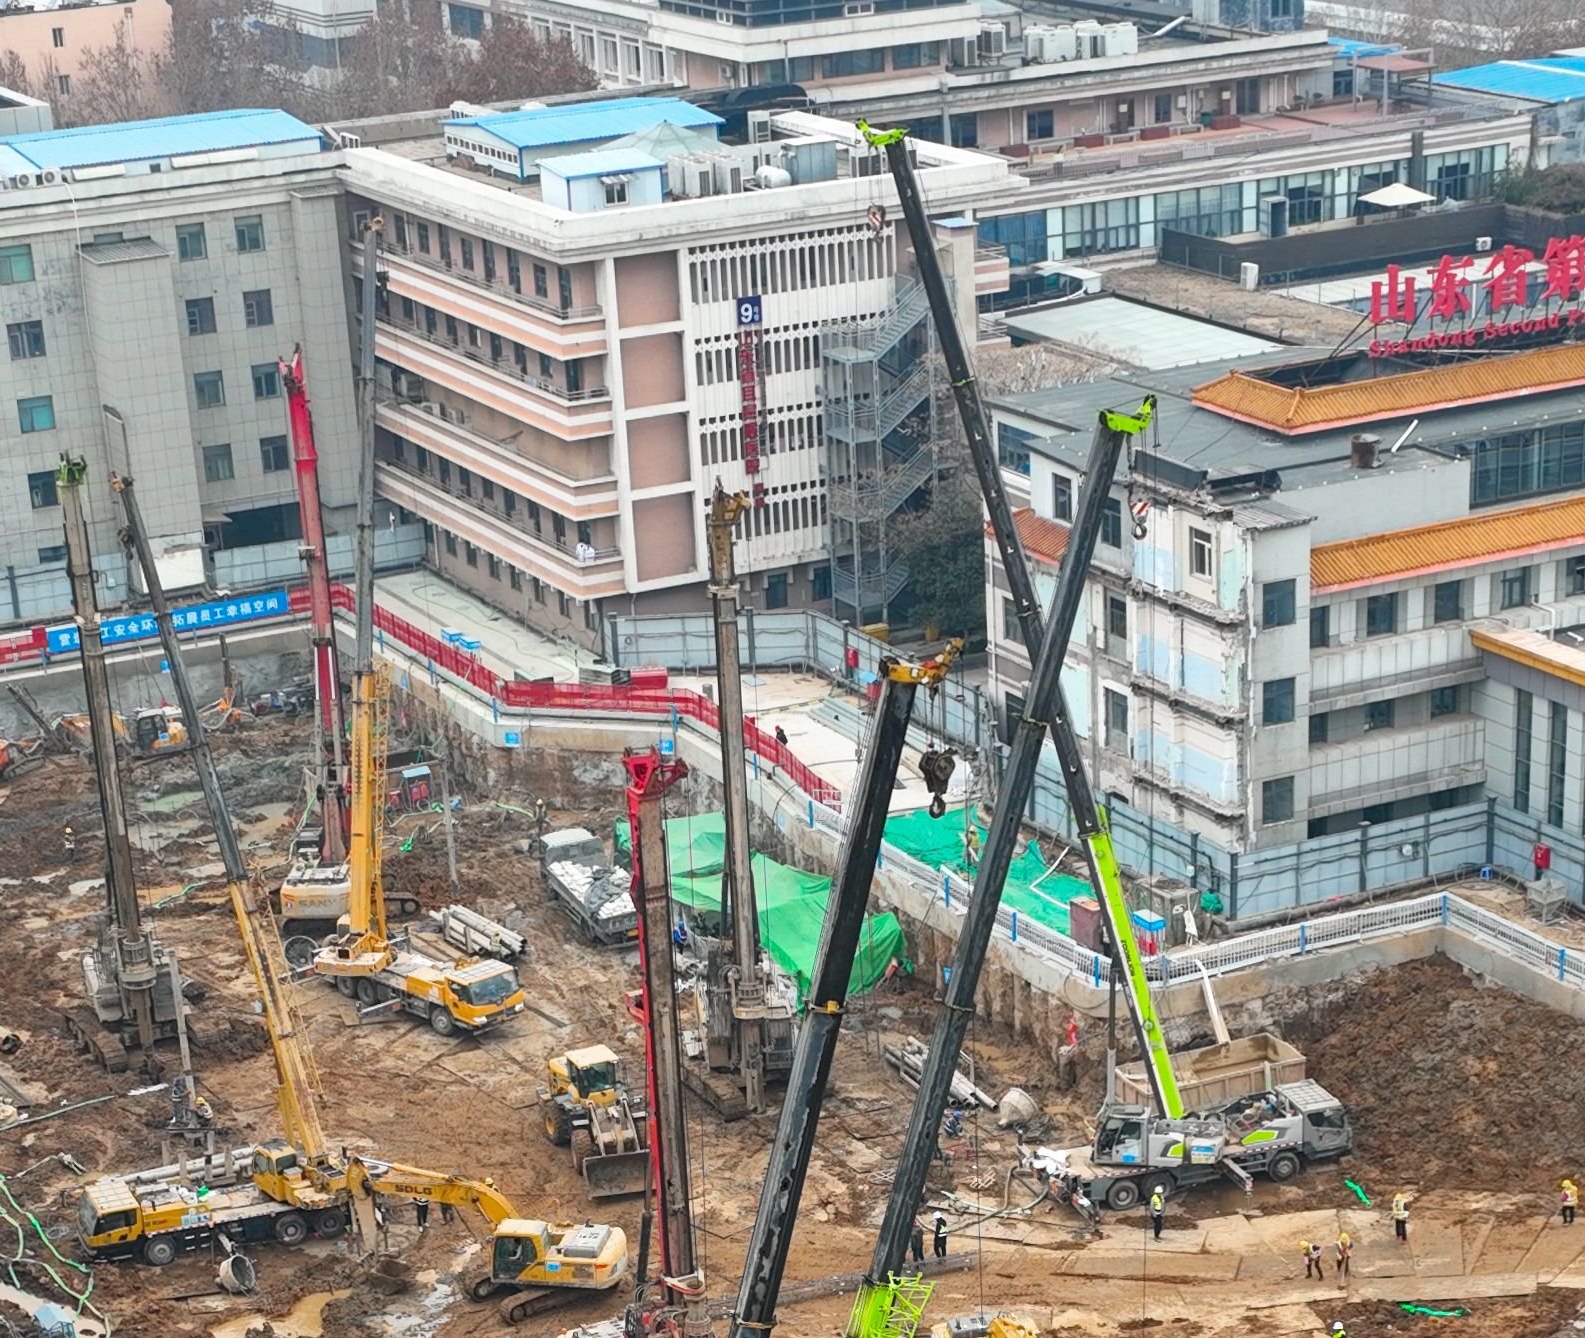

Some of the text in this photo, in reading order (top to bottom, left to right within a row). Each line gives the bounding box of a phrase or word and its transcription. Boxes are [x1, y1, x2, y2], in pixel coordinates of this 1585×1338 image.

[1369, 327, 1475, 358] Shandong
[1484, 311, 1560, 340] Second
[395, 1184, 433, 1197] SDLG
